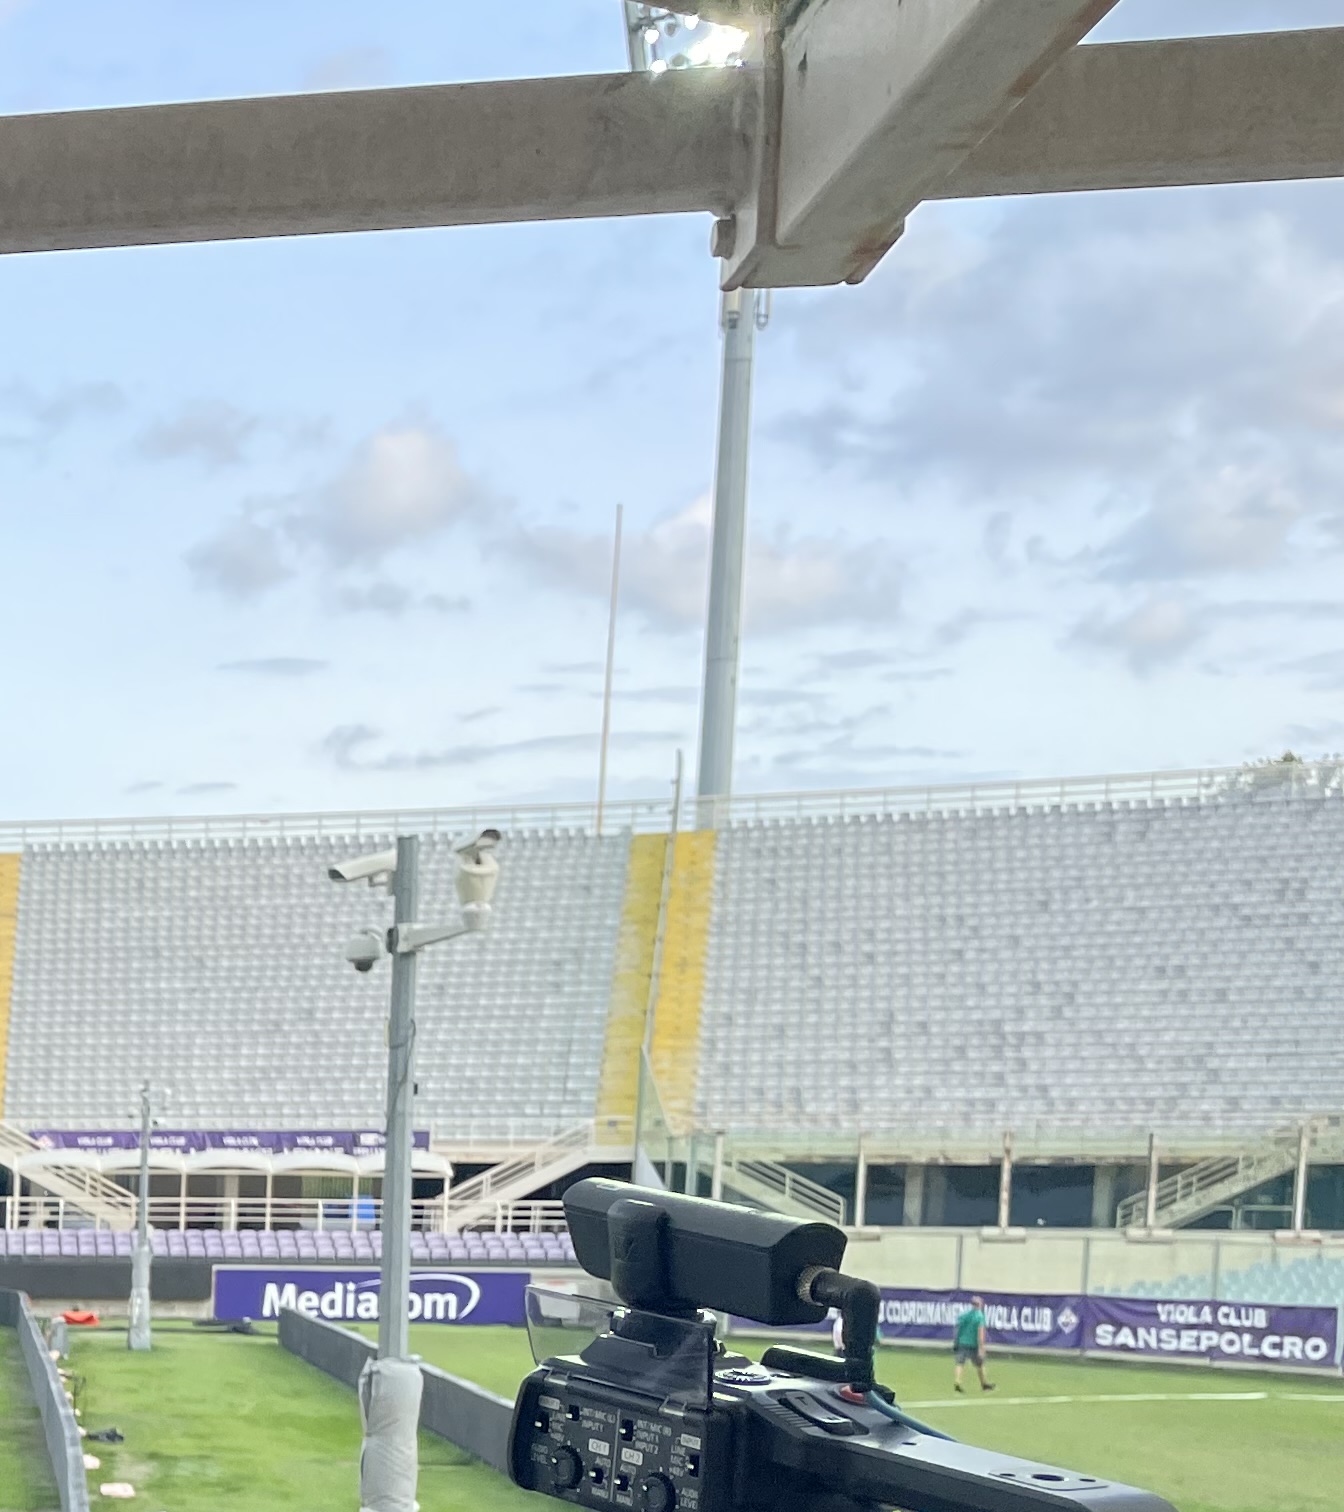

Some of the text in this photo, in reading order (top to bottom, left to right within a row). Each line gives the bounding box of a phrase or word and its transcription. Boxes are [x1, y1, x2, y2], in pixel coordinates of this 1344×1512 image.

[262, 1280, 458, 1321] Mediaom
[1156, 1303, 1268, 1329] VIOLA CLUB
[1020, 1306, 1052, 1332] CLUB
[1094, 1323, 1329, 1361] SANSEPOLCRO
